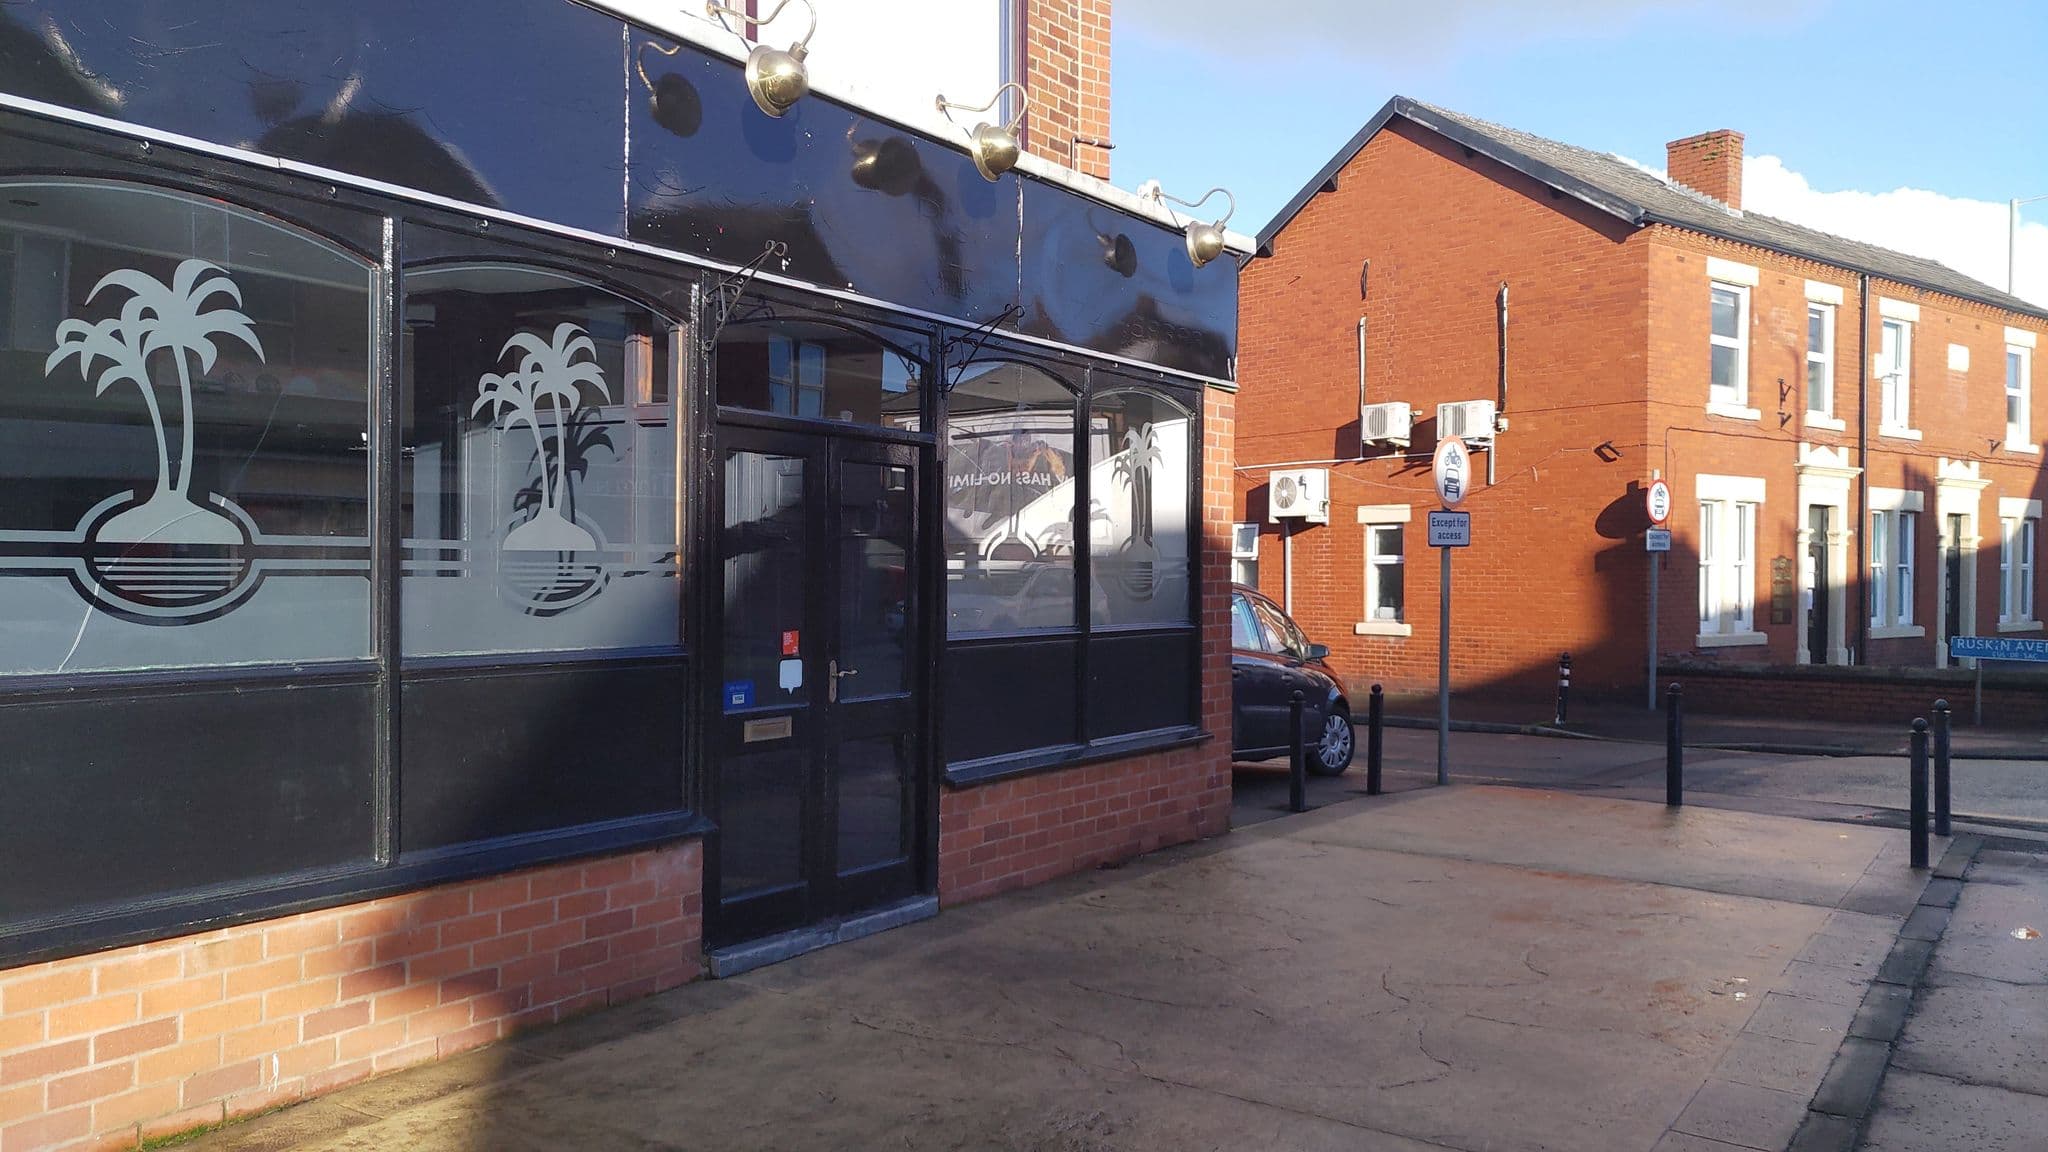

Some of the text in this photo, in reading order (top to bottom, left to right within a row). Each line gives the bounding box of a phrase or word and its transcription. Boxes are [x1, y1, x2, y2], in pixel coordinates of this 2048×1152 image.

[1431, 517, 1467, 528] Except for
[1437, 531, 1462, 540] access
[1957, 638, 2010, 651] RUSKIN
